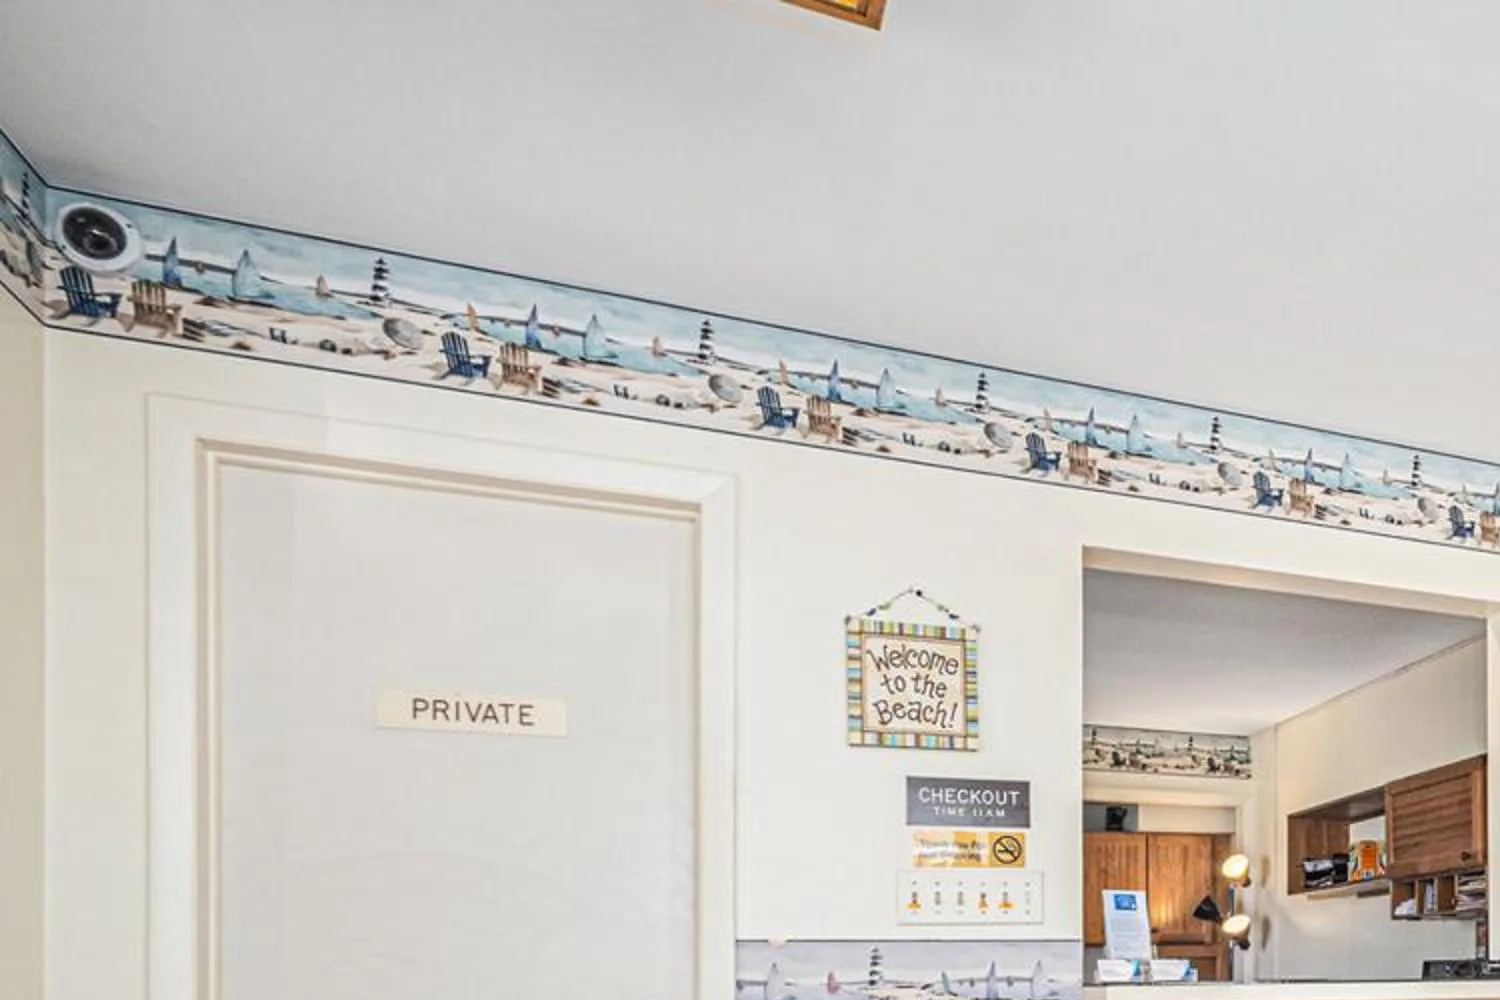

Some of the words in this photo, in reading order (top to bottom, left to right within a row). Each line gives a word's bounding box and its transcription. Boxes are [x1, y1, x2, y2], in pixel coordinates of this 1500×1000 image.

[866, 644, 959, 675] Welcome
[880, 673, 907, 695] to
[911, 672, 948, 698] the
[411, 697, 536, 727] PRIVATE
[872, 699, 959, 728] Beach!
[918, 786, 1021, 807] CHECKOUT
[933, 806, 966, 817] TIME
